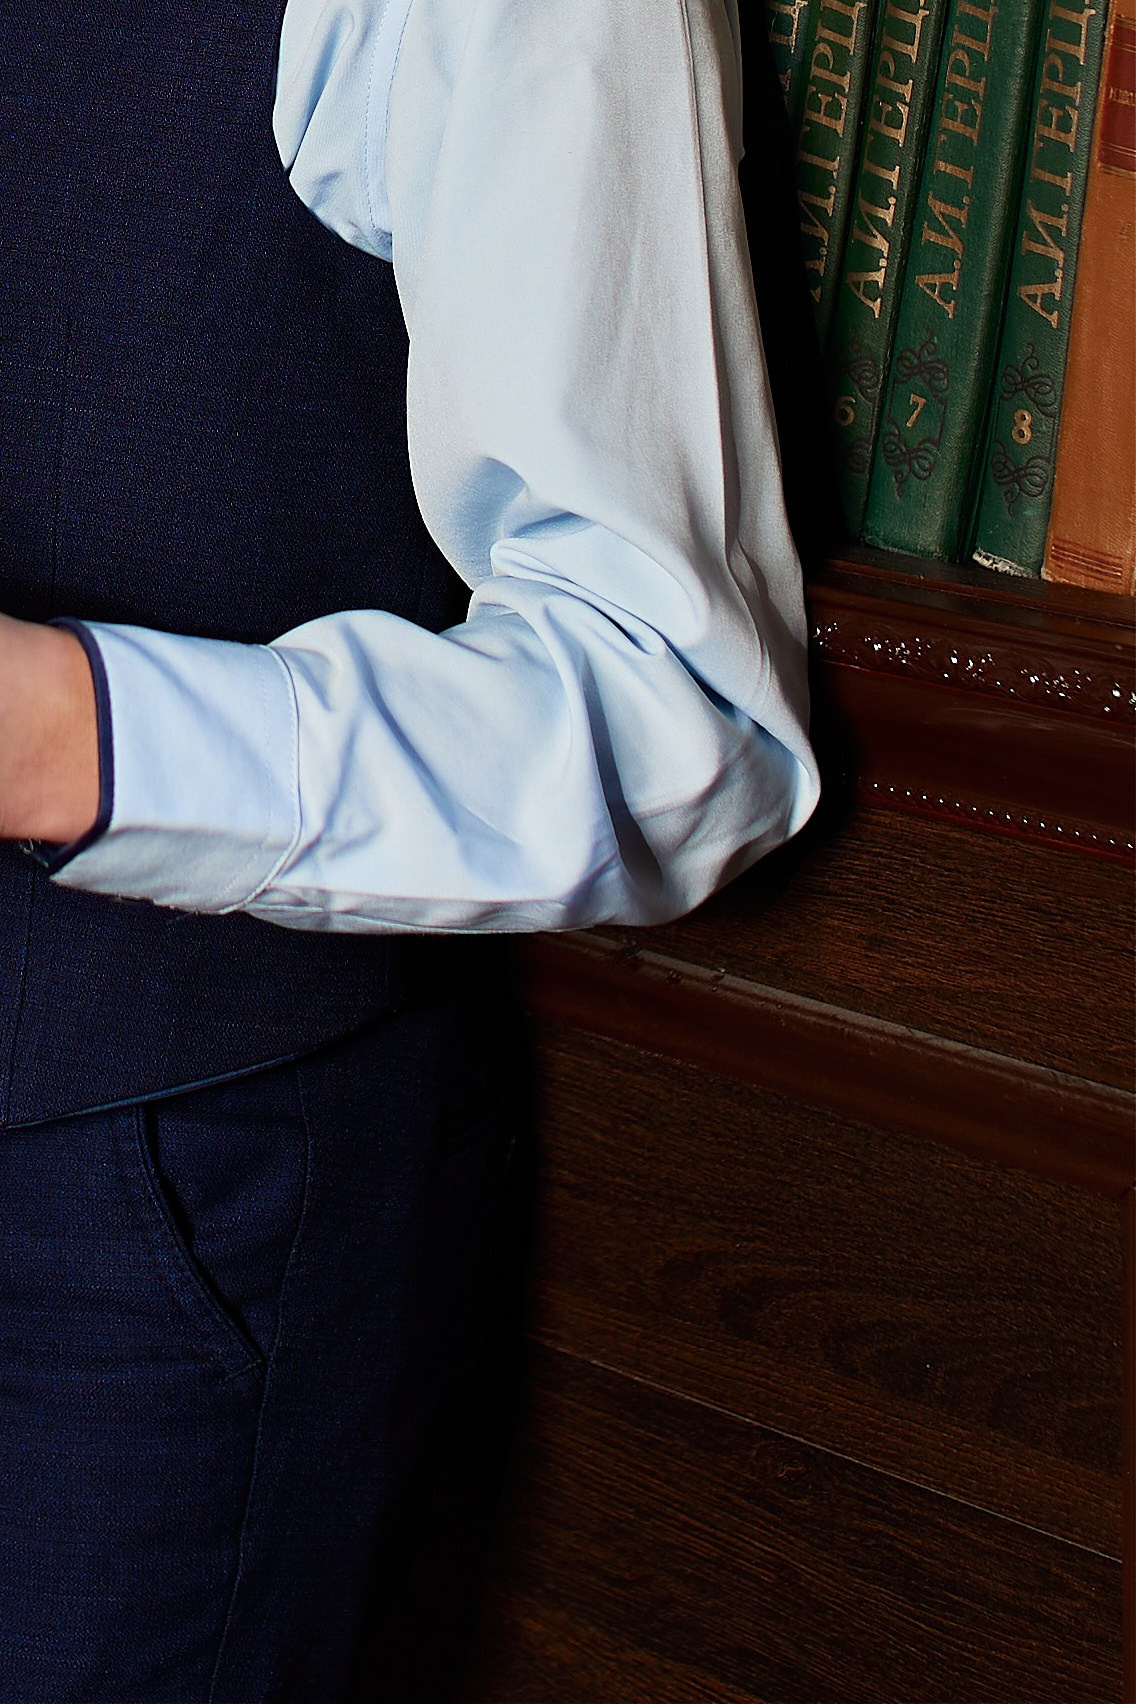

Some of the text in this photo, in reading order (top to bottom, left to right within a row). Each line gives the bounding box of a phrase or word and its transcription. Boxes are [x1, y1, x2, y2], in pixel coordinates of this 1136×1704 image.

[835, 395, 856, 427] 6
[905, 392, 927, 429] 7
[1011, 408, 1033, 445] 8
